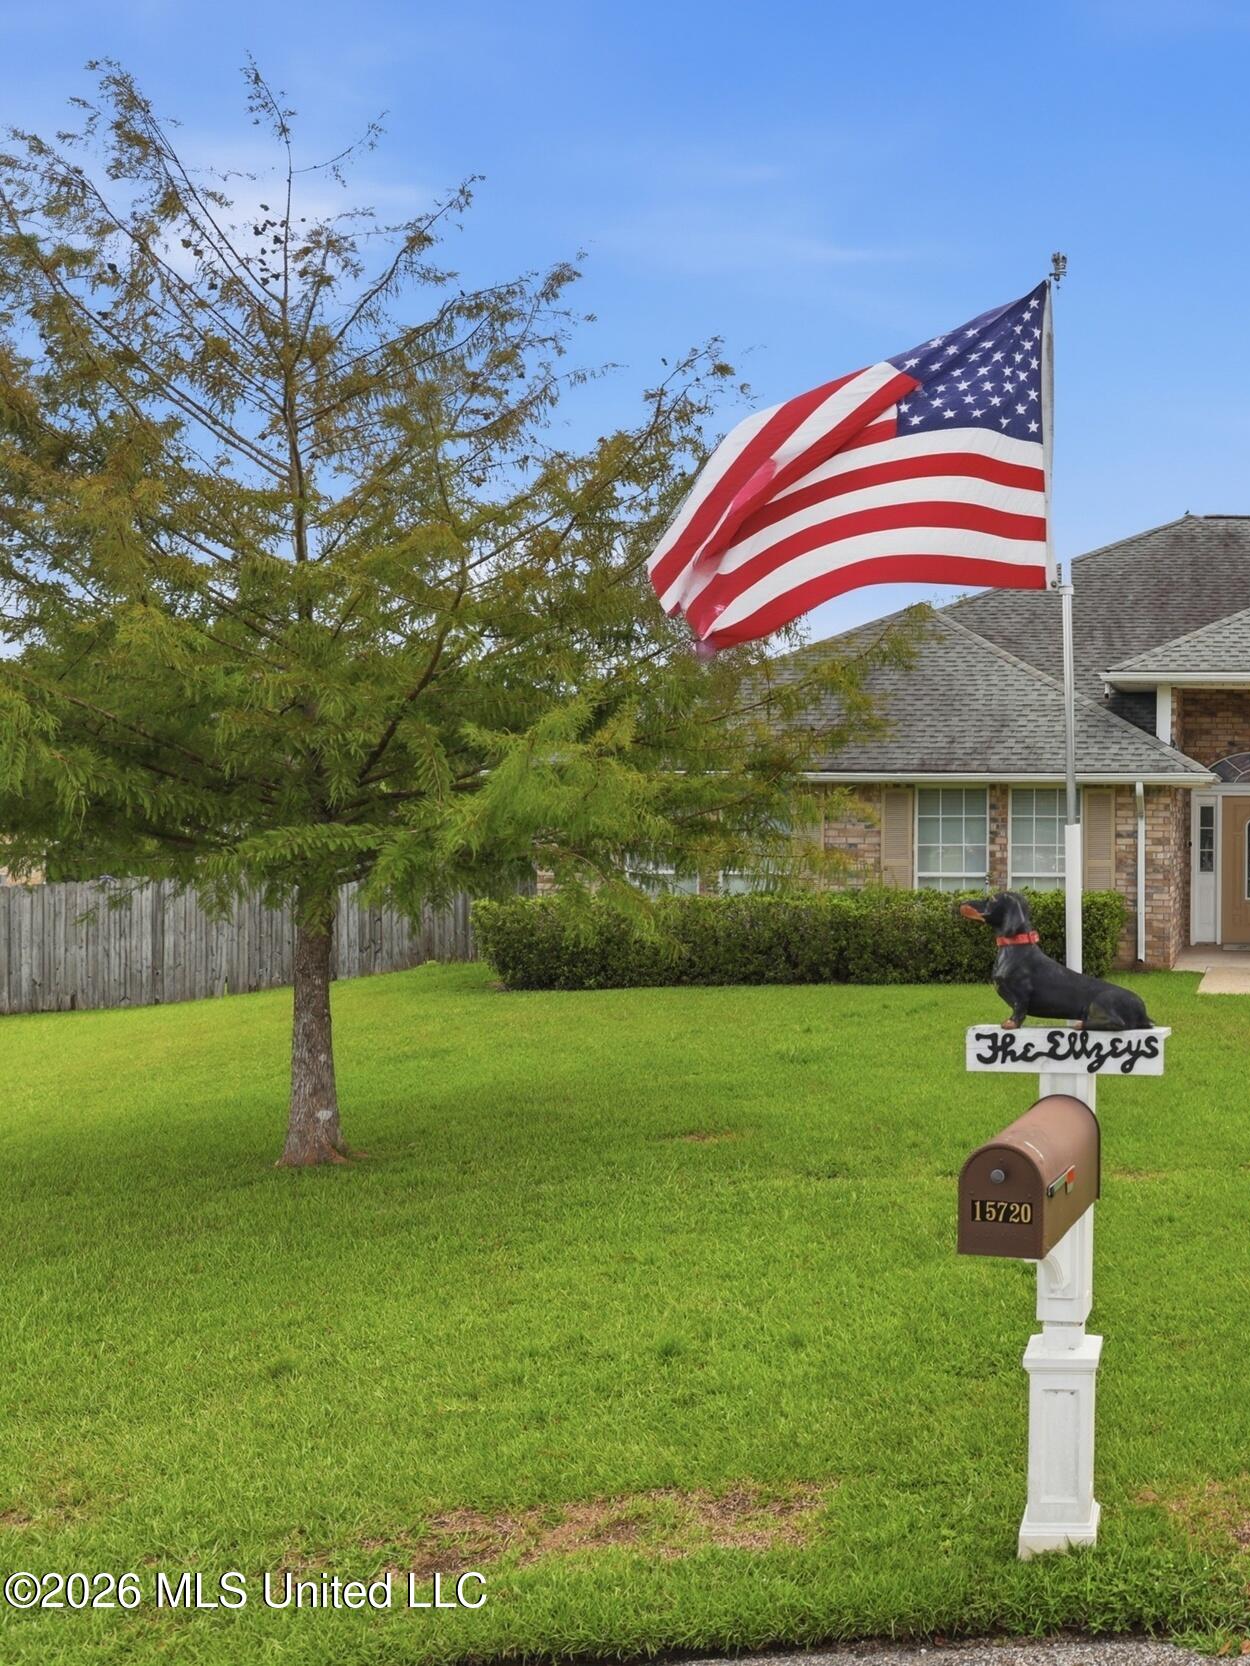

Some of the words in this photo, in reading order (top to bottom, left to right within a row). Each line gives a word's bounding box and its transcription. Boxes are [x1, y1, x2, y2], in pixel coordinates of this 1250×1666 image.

[975, 1032, 1044, 1065] The
[1046, 1030, 1160, 1074] Ellzeys
[973, 1201, 1032, 1224] 15720
